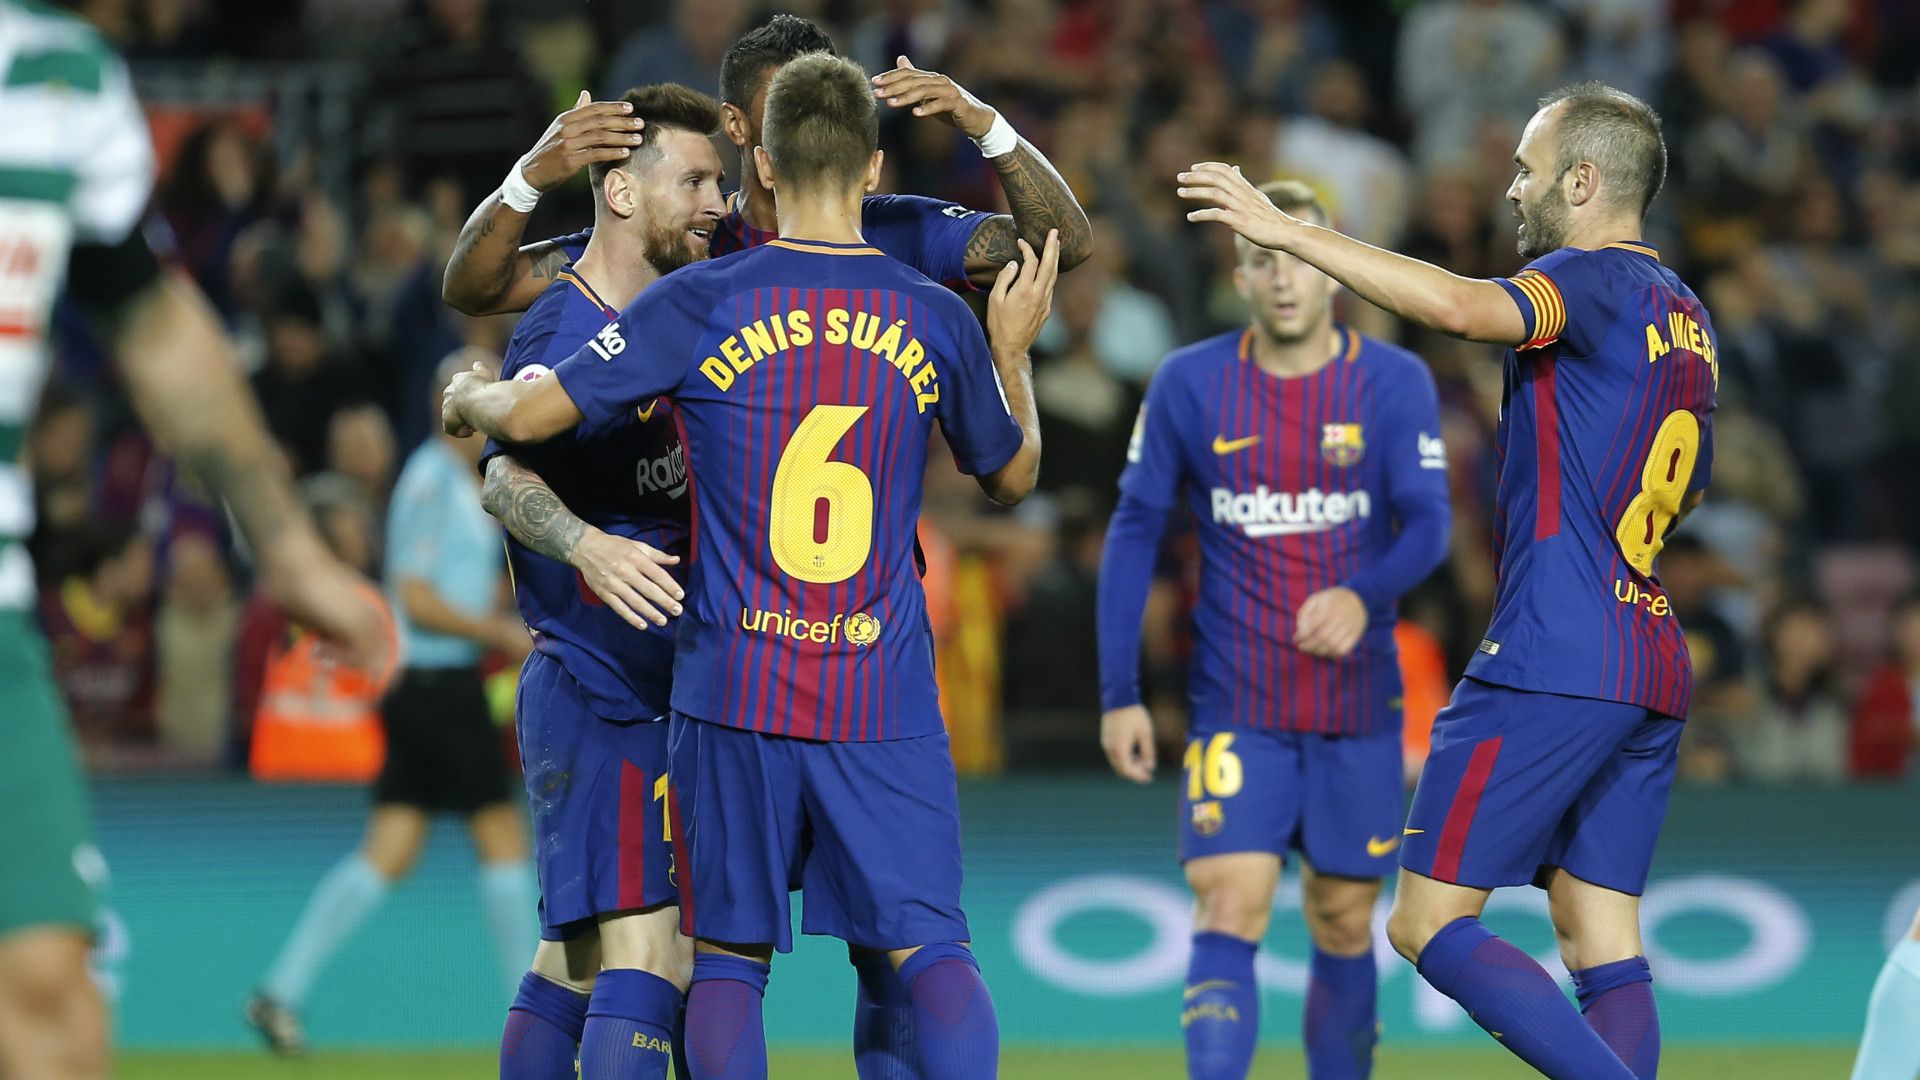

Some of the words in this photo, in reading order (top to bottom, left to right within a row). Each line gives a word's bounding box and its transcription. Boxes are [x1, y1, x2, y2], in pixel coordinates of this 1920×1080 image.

[699, 309, 814, 392] DENIS
[825, 308, 940, 414] SUÁREZ
[1646, 323, 1670, 363] A.
[768, 403, 875, 585] 6
[1211, 485, 1372, 525] Rakuten
[1615, 408, 1700, 578] 8
[742, 607, 843, 644] unicef
[1183, 731, 1244, 802] 16
